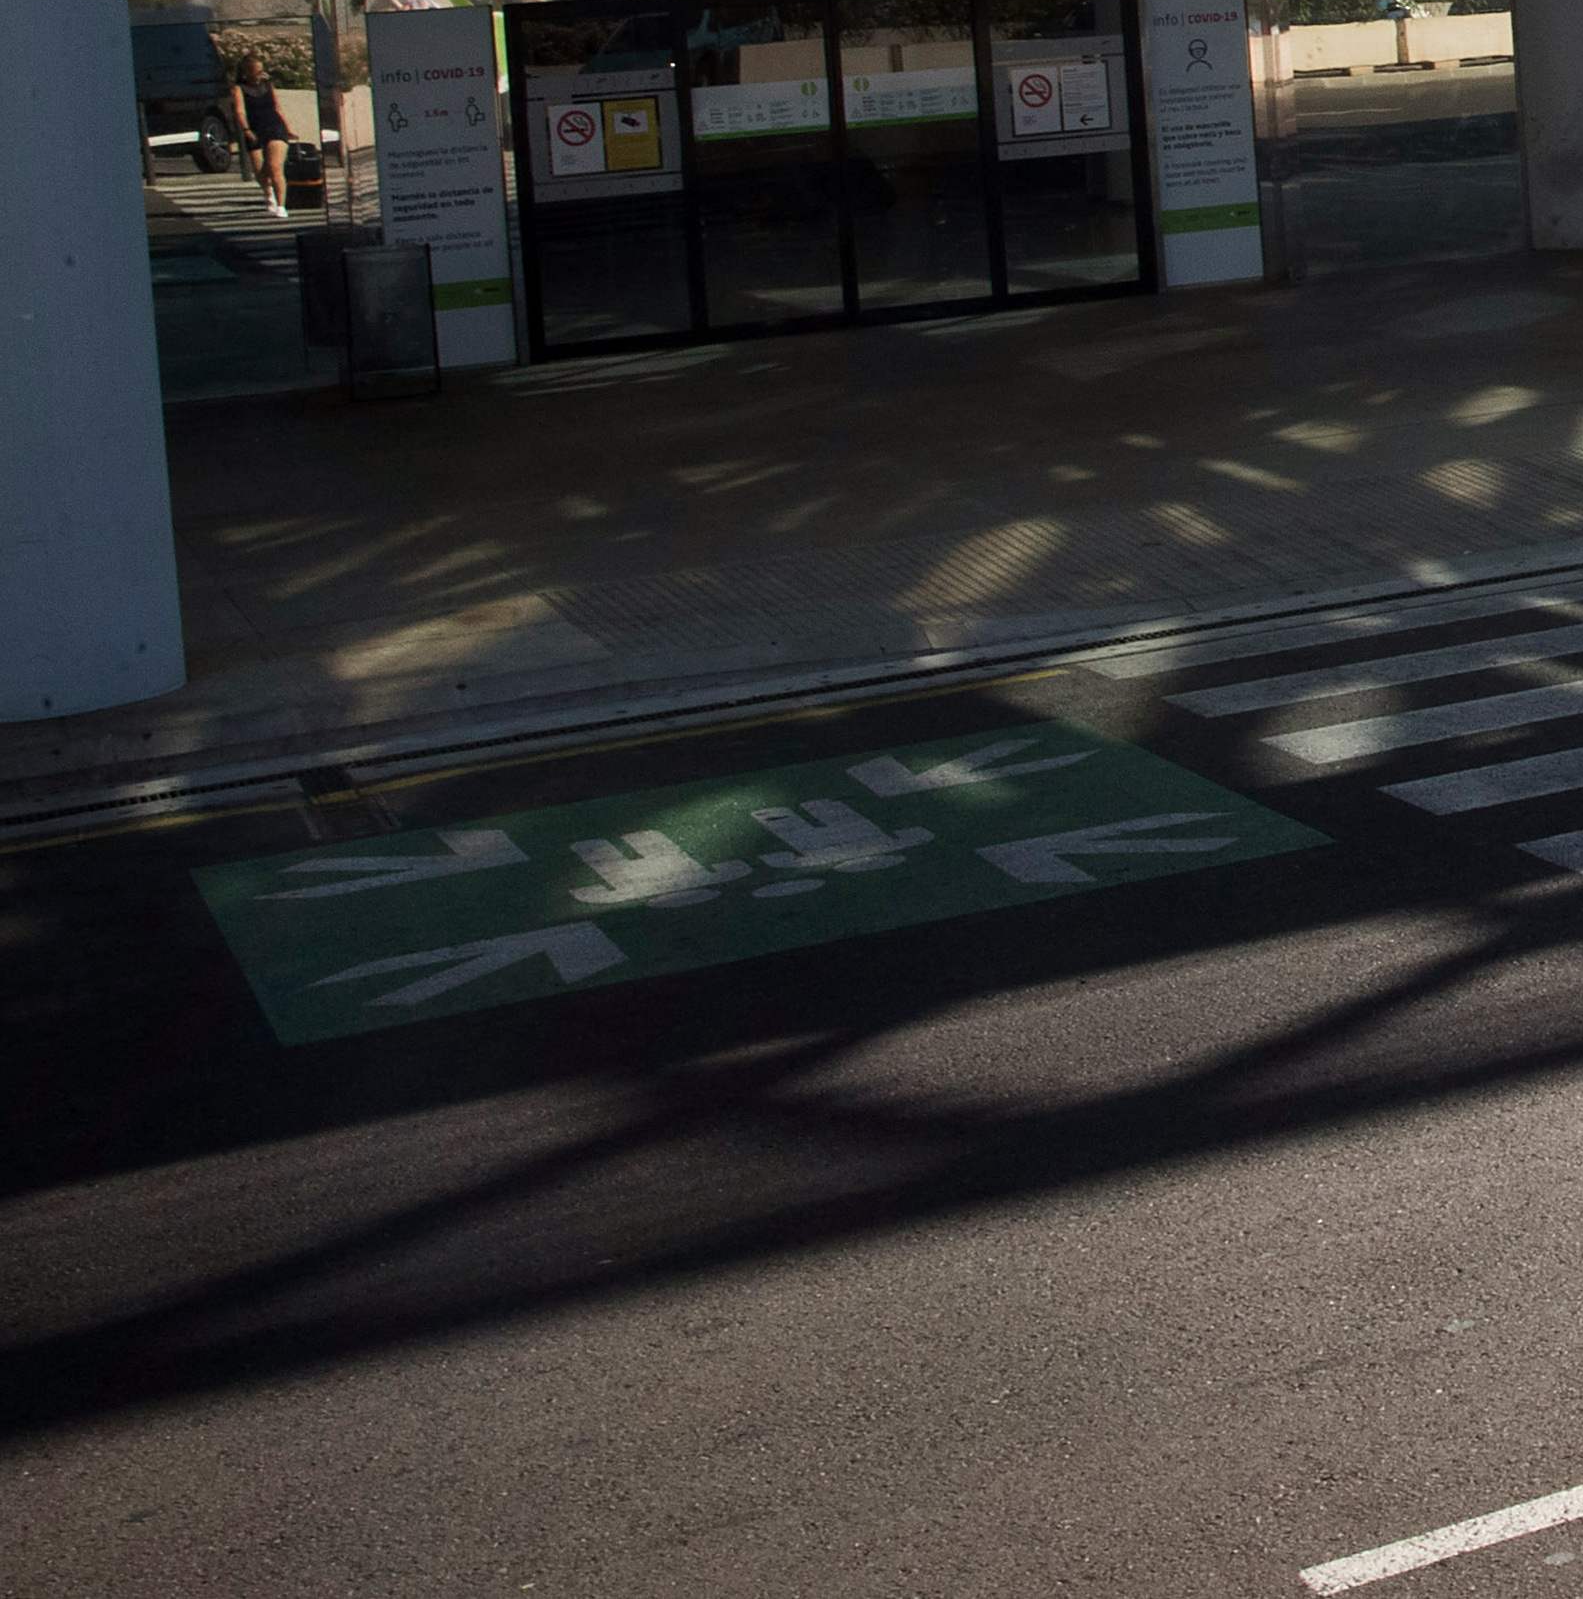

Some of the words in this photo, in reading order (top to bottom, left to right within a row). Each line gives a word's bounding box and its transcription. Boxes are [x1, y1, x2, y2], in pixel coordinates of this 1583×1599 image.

[1188, 11, 1238, 25] COVID-19
[380, 68, 412, 83] info
[423, 66, 485, 82] COVID-19
